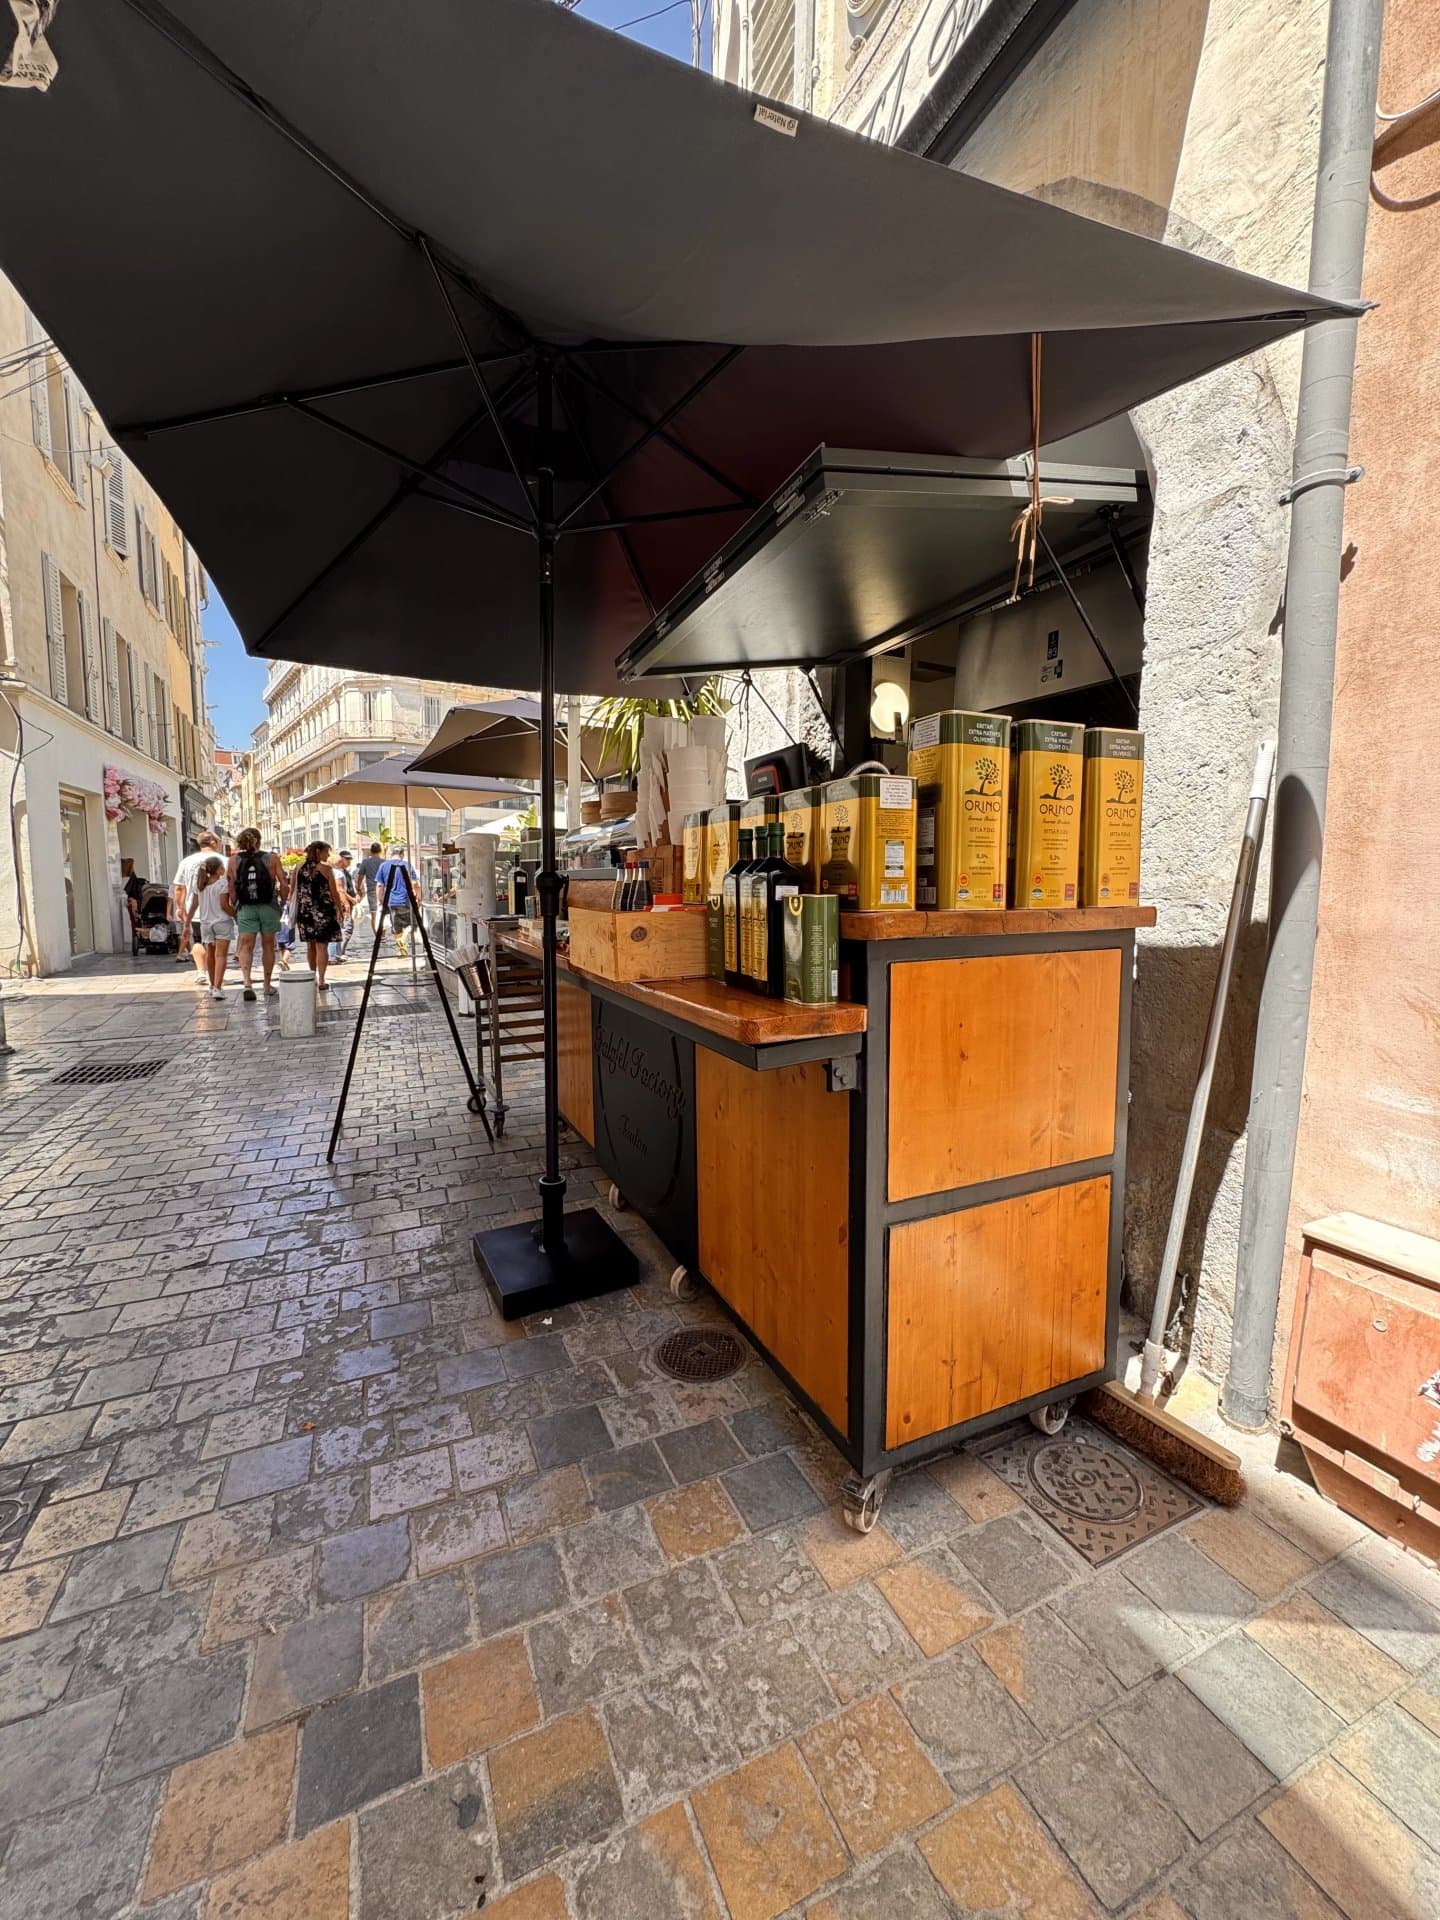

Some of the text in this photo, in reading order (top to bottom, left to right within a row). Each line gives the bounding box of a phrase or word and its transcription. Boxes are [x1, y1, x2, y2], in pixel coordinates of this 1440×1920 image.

[758, 107, 787, 128] Naterial
[964, 799, 1001, 814] ORINO
[1039, 803, 1074, 817] ORINO
[1106, 807, 1136, 820] ORINO
[630, 1047, 688, 1120] Factory
